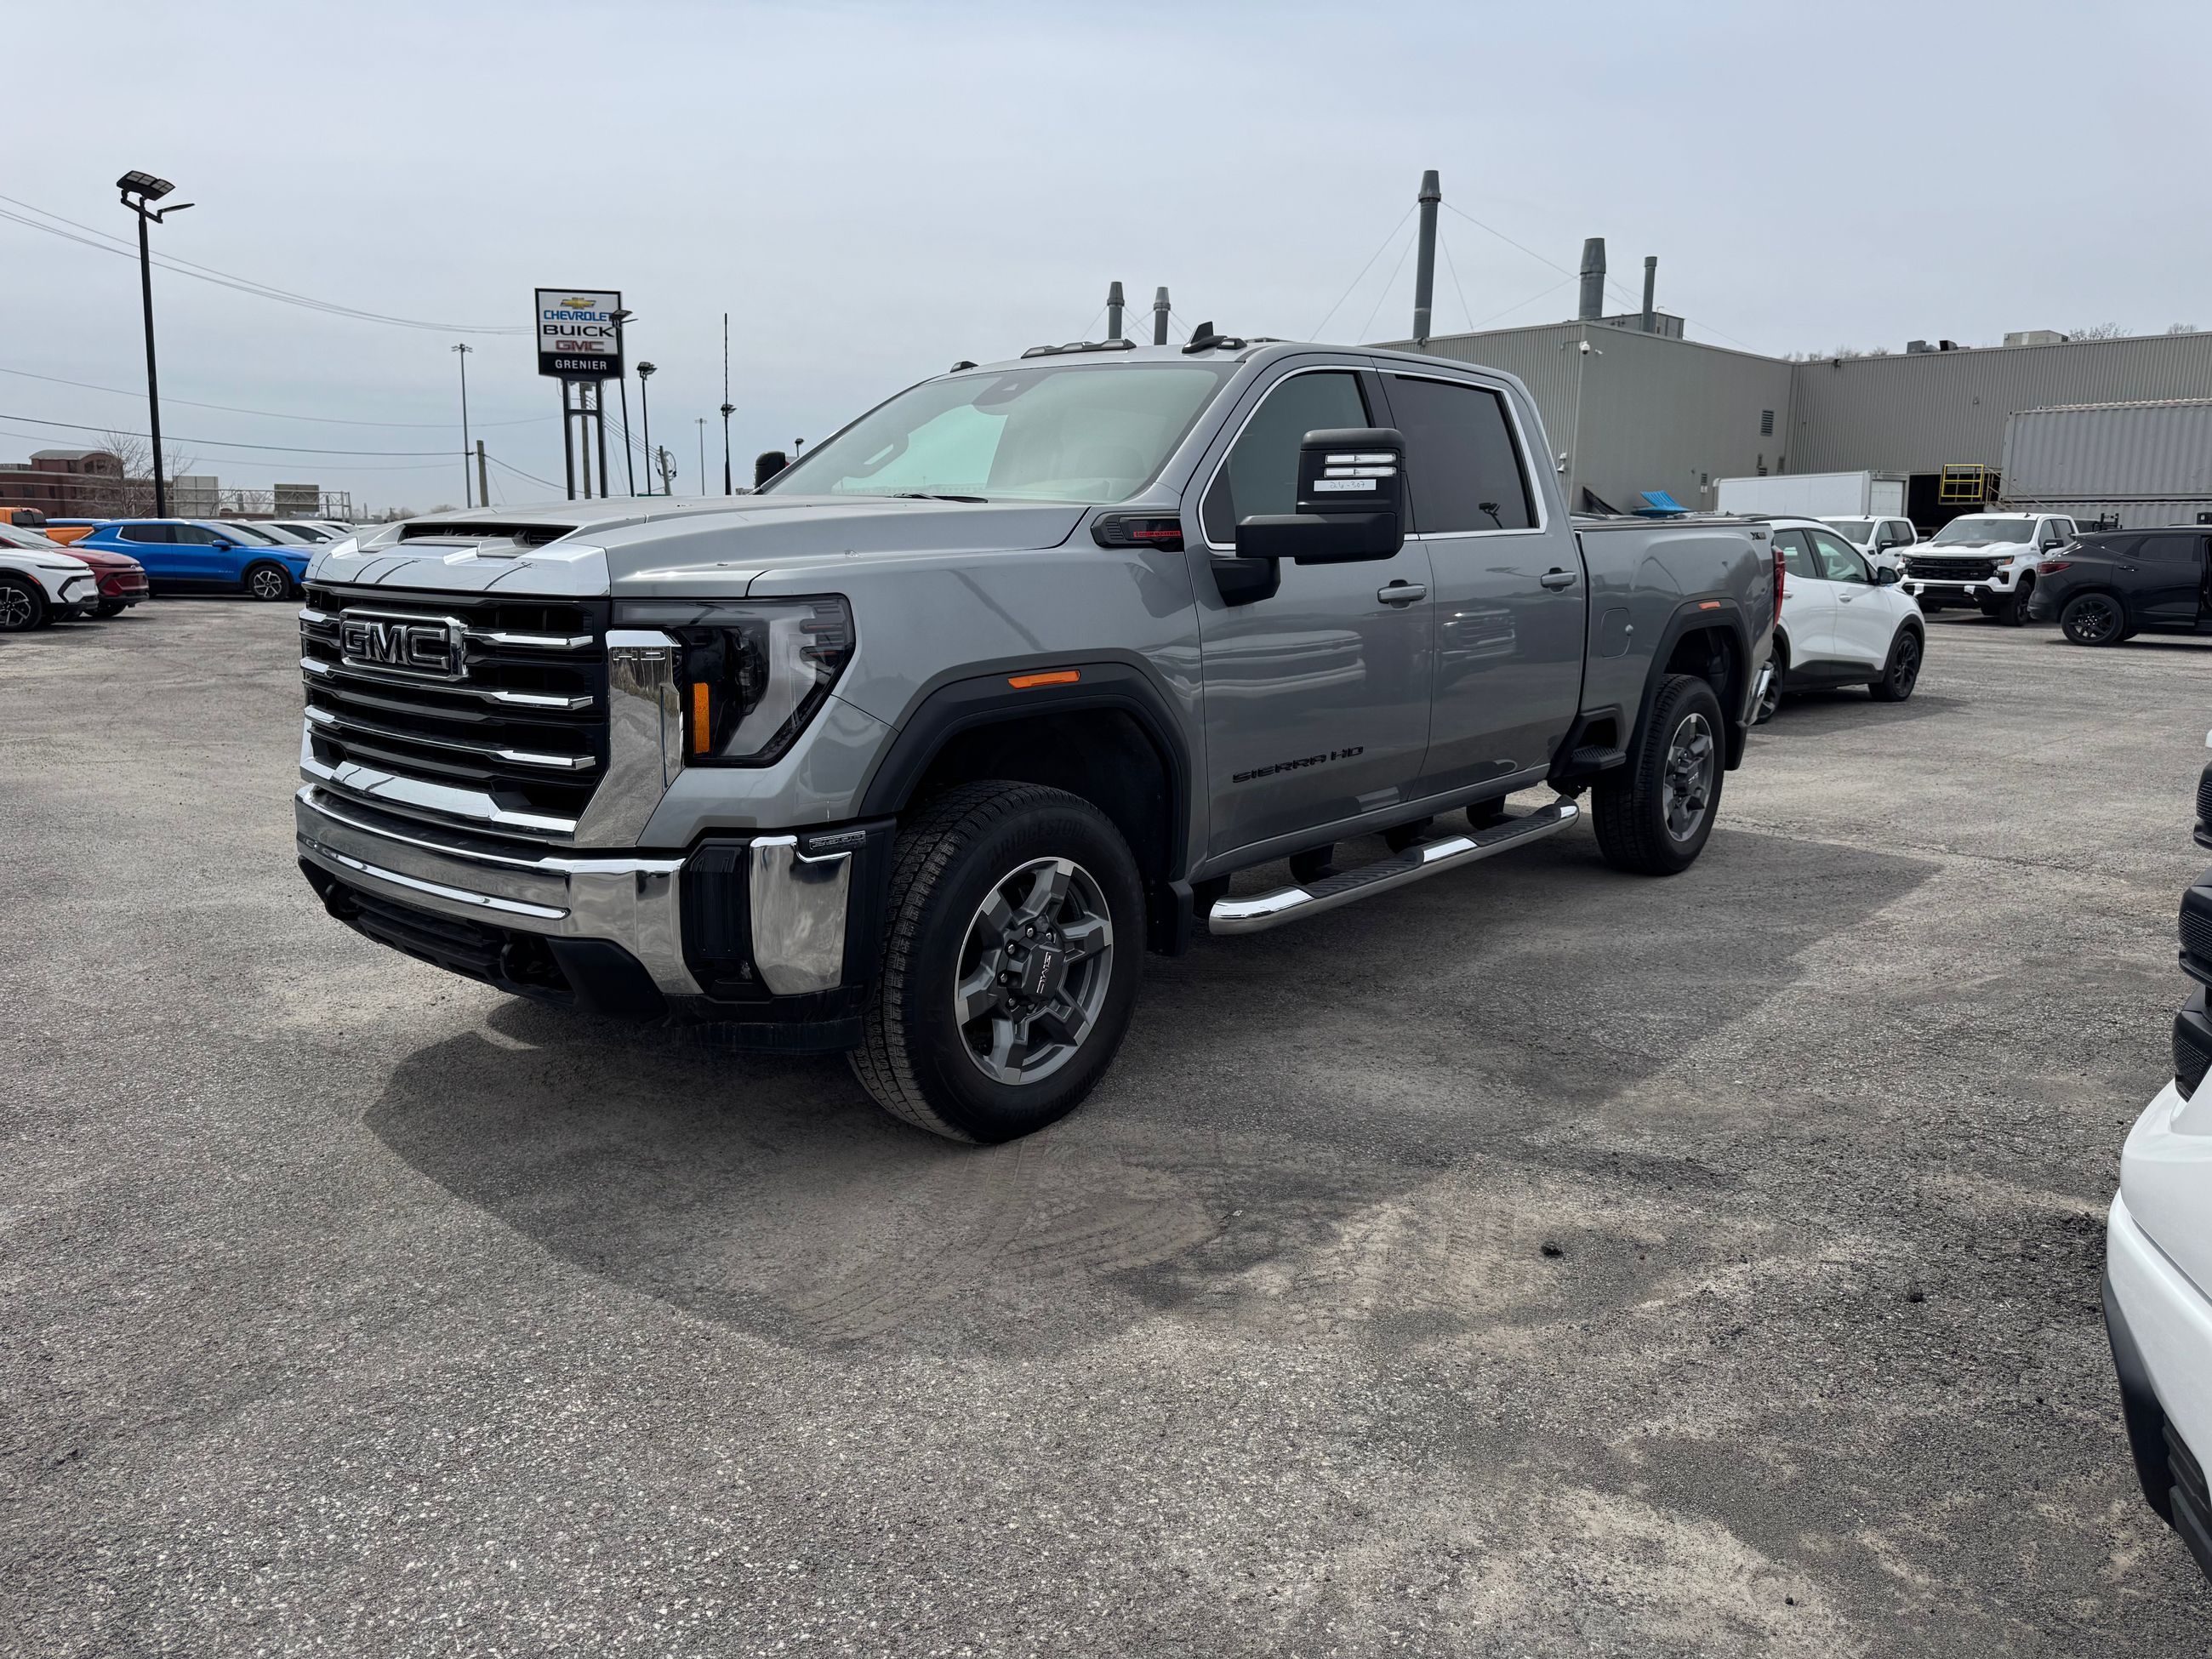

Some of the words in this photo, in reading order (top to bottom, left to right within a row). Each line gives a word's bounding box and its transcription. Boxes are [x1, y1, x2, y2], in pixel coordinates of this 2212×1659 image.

[543, 325, 615, 338] BUICK
[556, 339, 605, 352] GMC
[555, 359, 607, 370] GRENIER
[342, 619, 449, 670] GMC
[613, 650, 666, 661] HD
[1232, 754, 1327, 784] SIERRA
[1331, 745, 1365, 761] HD
[1036, 951, 1052, 995] GMC
